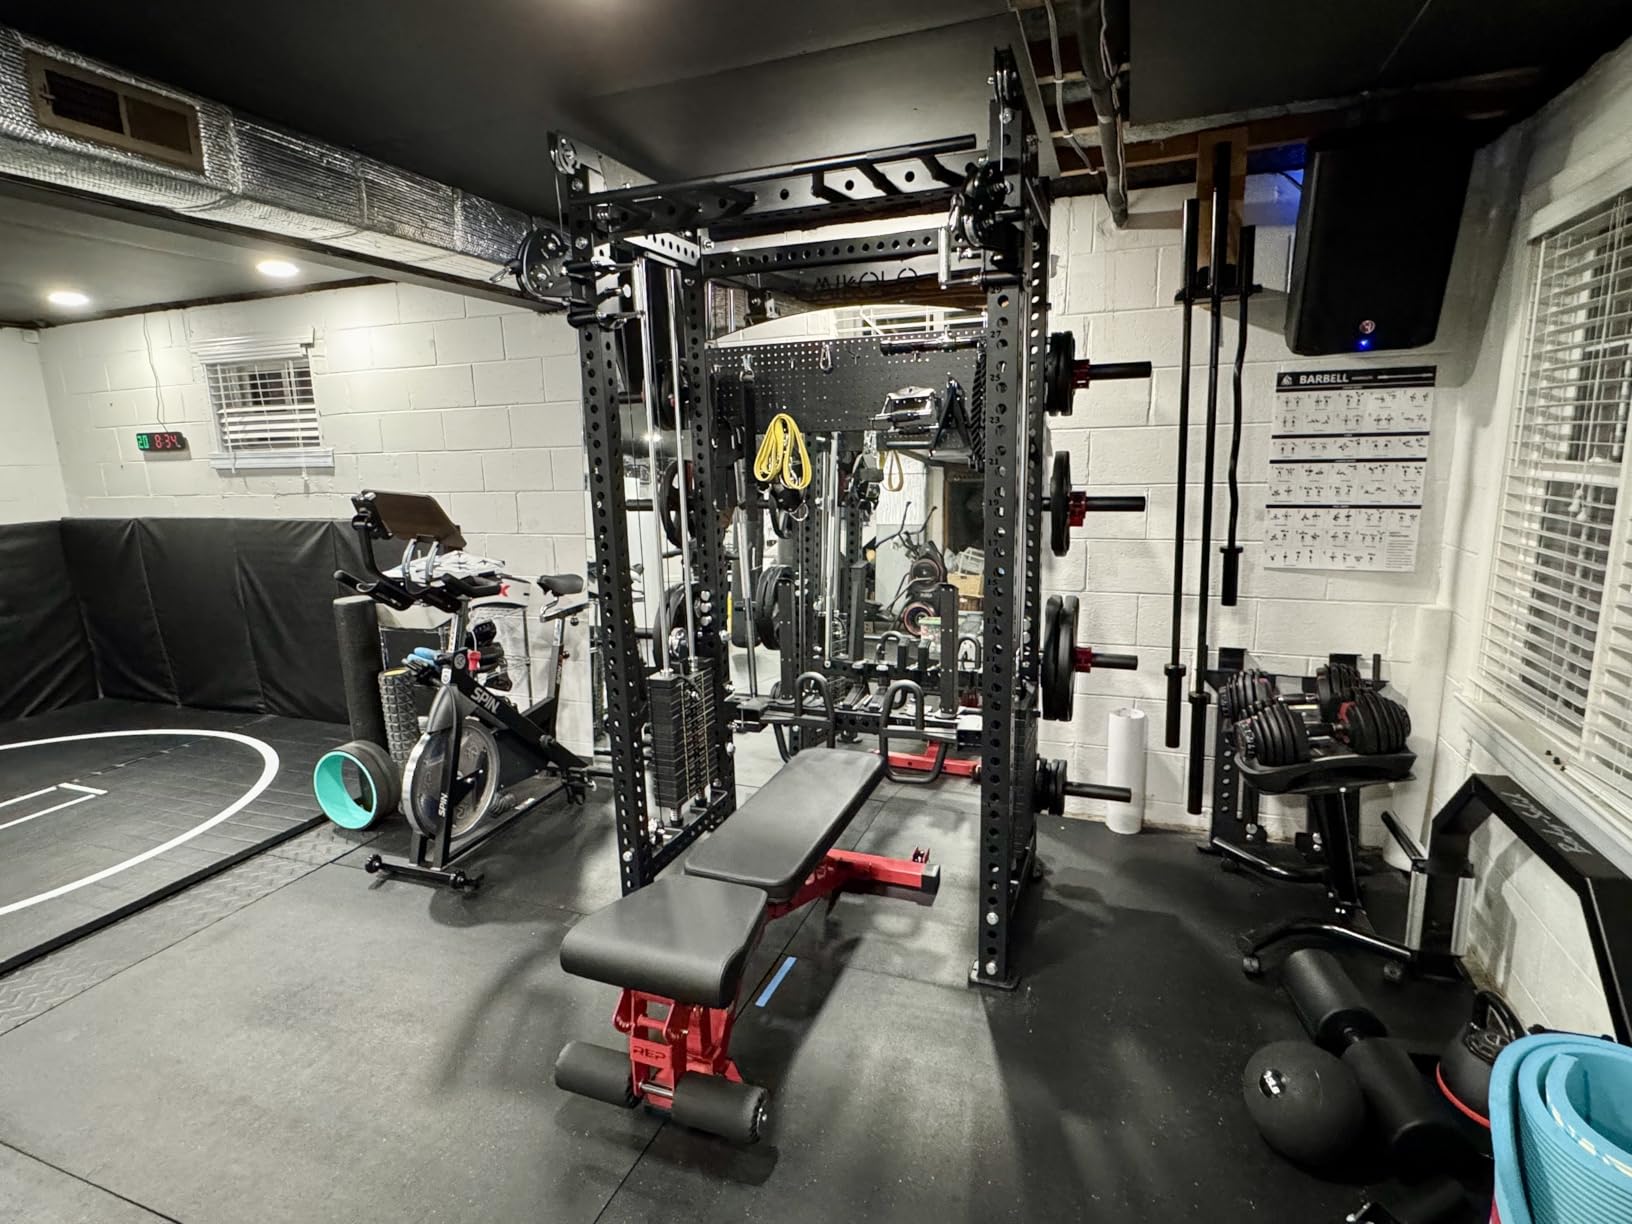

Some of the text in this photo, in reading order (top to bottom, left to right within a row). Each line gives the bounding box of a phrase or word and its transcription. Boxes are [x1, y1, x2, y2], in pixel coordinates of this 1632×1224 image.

[990, 330, 1002, 338] 27
[1300, 373, 1349, 384] BARBELL
[989, 416, 1000, 424] 23
[470, 686, 501, 714] SPIN
[438, 792, 448, 818] SPIN
[633, 1045, 666, 1060] REP
